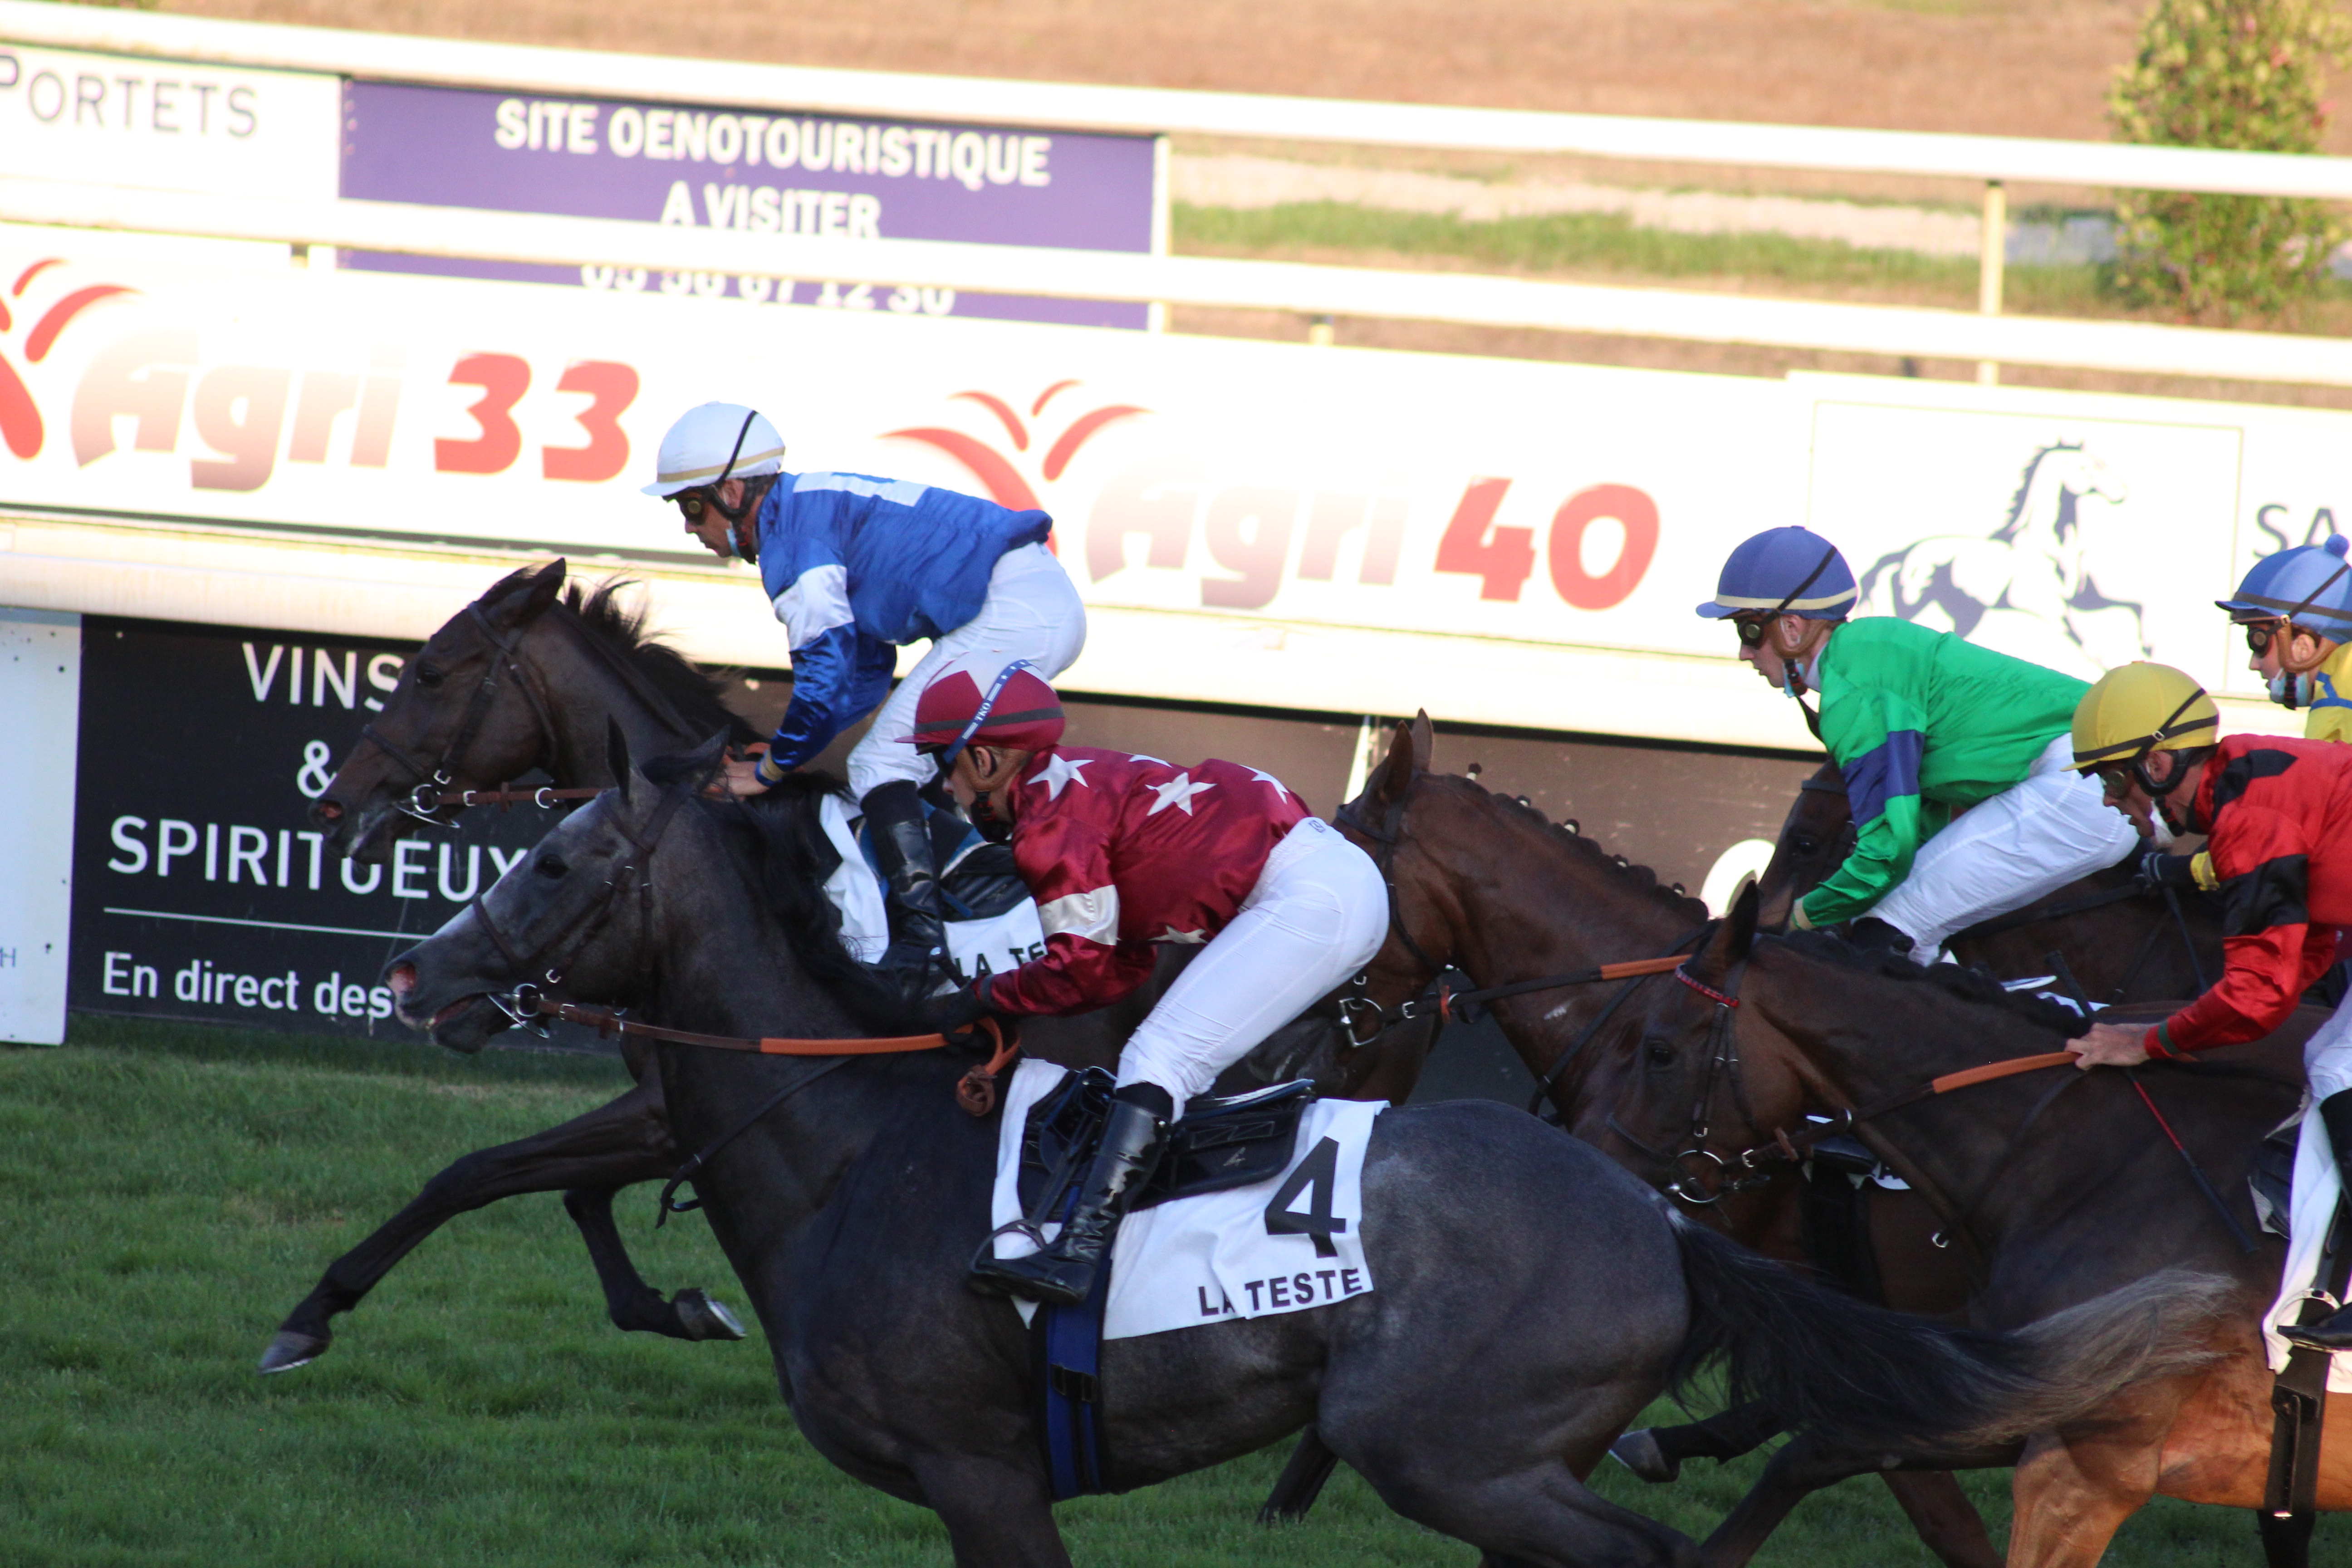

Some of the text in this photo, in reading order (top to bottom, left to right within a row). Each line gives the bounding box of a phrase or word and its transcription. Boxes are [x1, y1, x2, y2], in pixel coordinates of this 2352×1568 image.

[495, 98, 1052, 192] SITE OENOTOURISTIQUE
[660, 180, 882, 239] A VISITER
[70, 329, 640, 493] Agri 33
[1085, 467, 1661, 611] Agri 40
[242, 642, 405, 712] VINS
[296, 740, 337, 799] &
[103, 951, 393, 1019] En direct des
[1264, 1135, 1347, 1259] 4
[1245, 1268, 1363, 1311] TESTE
